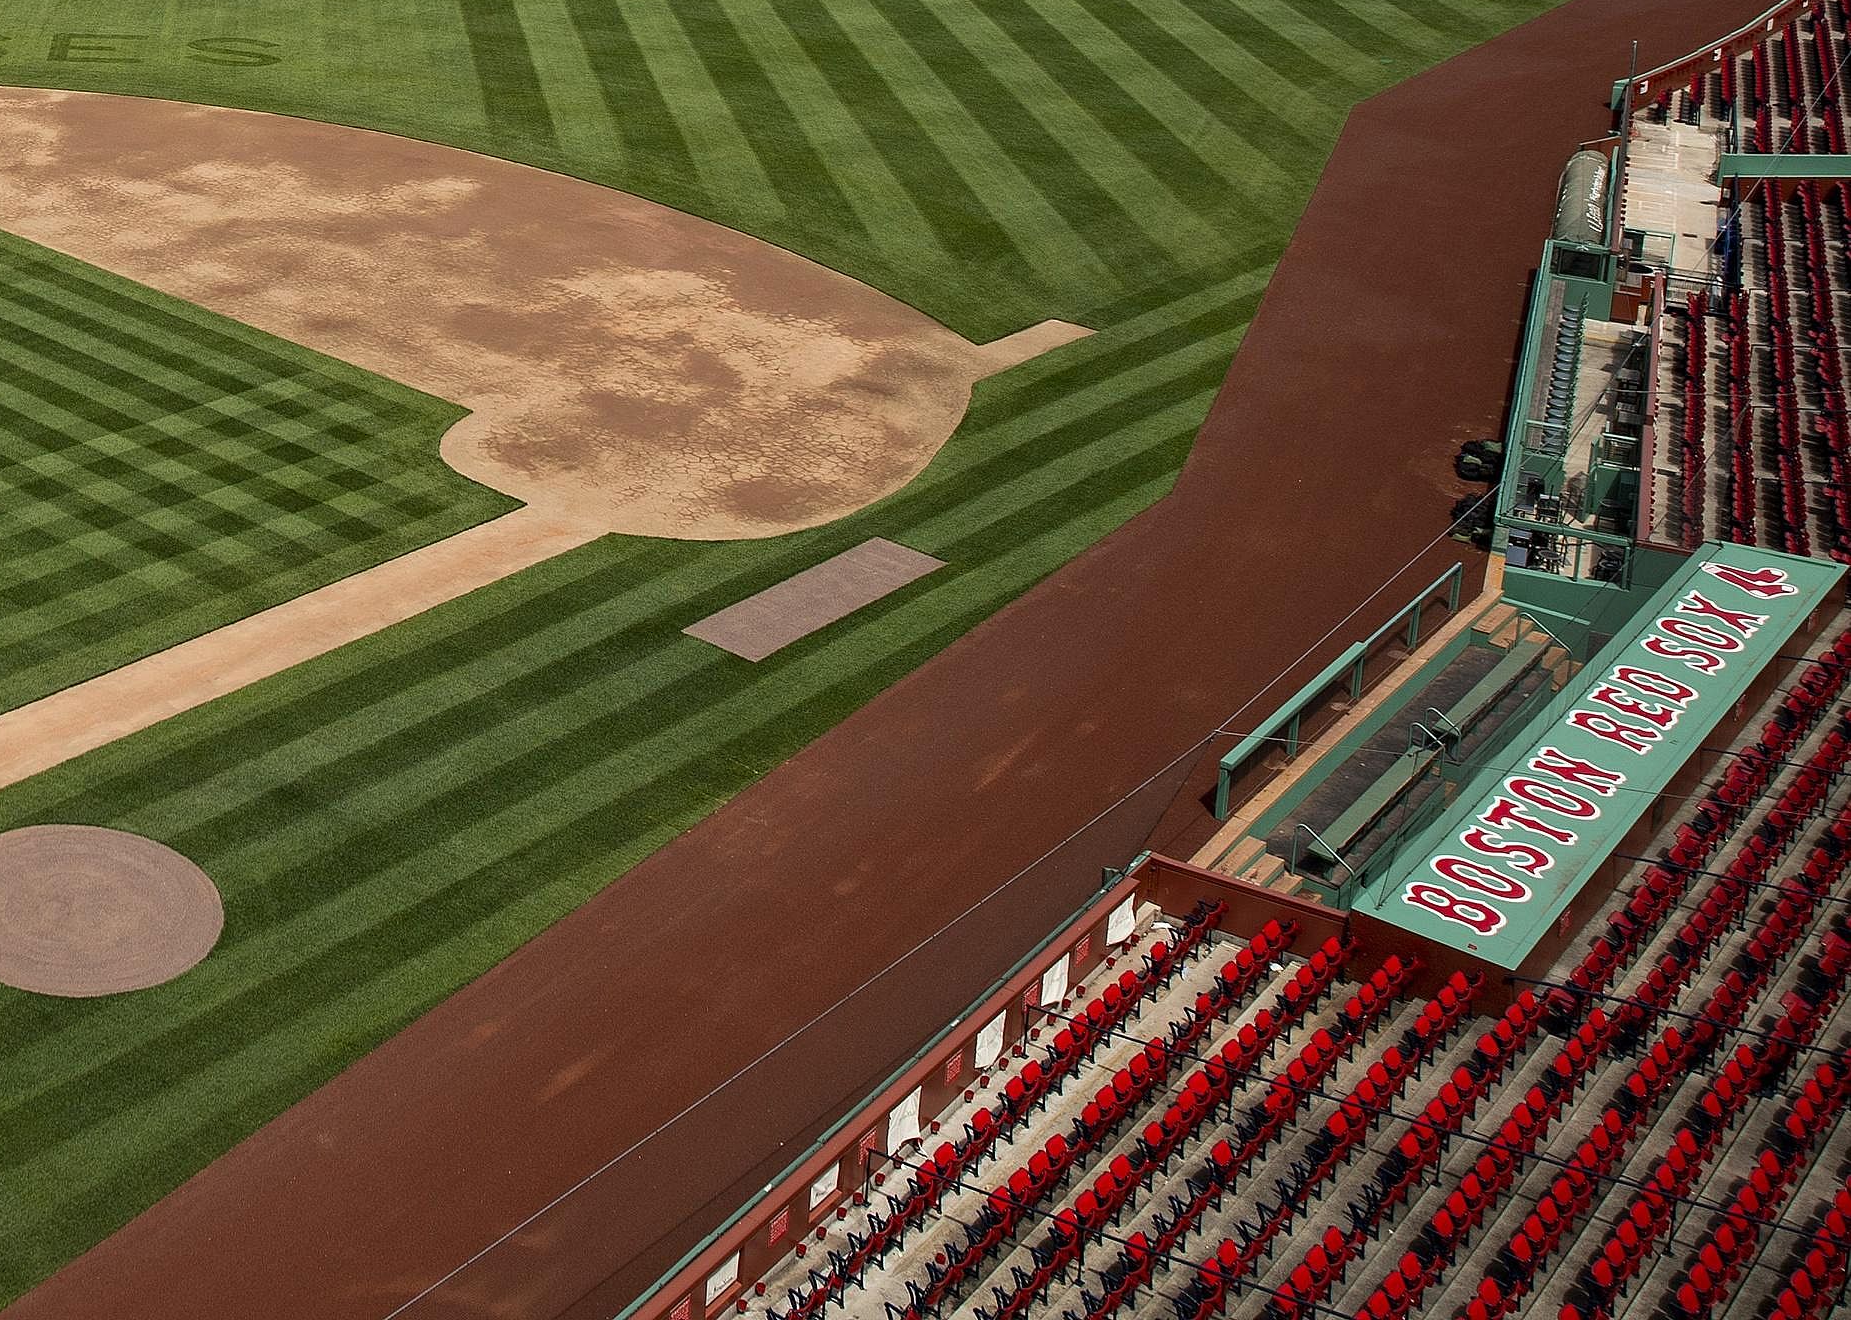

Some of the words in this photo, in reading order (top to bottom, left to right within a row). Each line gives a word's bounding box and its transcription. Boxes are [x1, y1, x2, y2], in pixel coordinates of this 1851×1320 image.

[1401, 744, 1629, 937] BOSTON
[1565, 663, 1701, 757] RED
[1640, 589, 1770, 677] SOX
